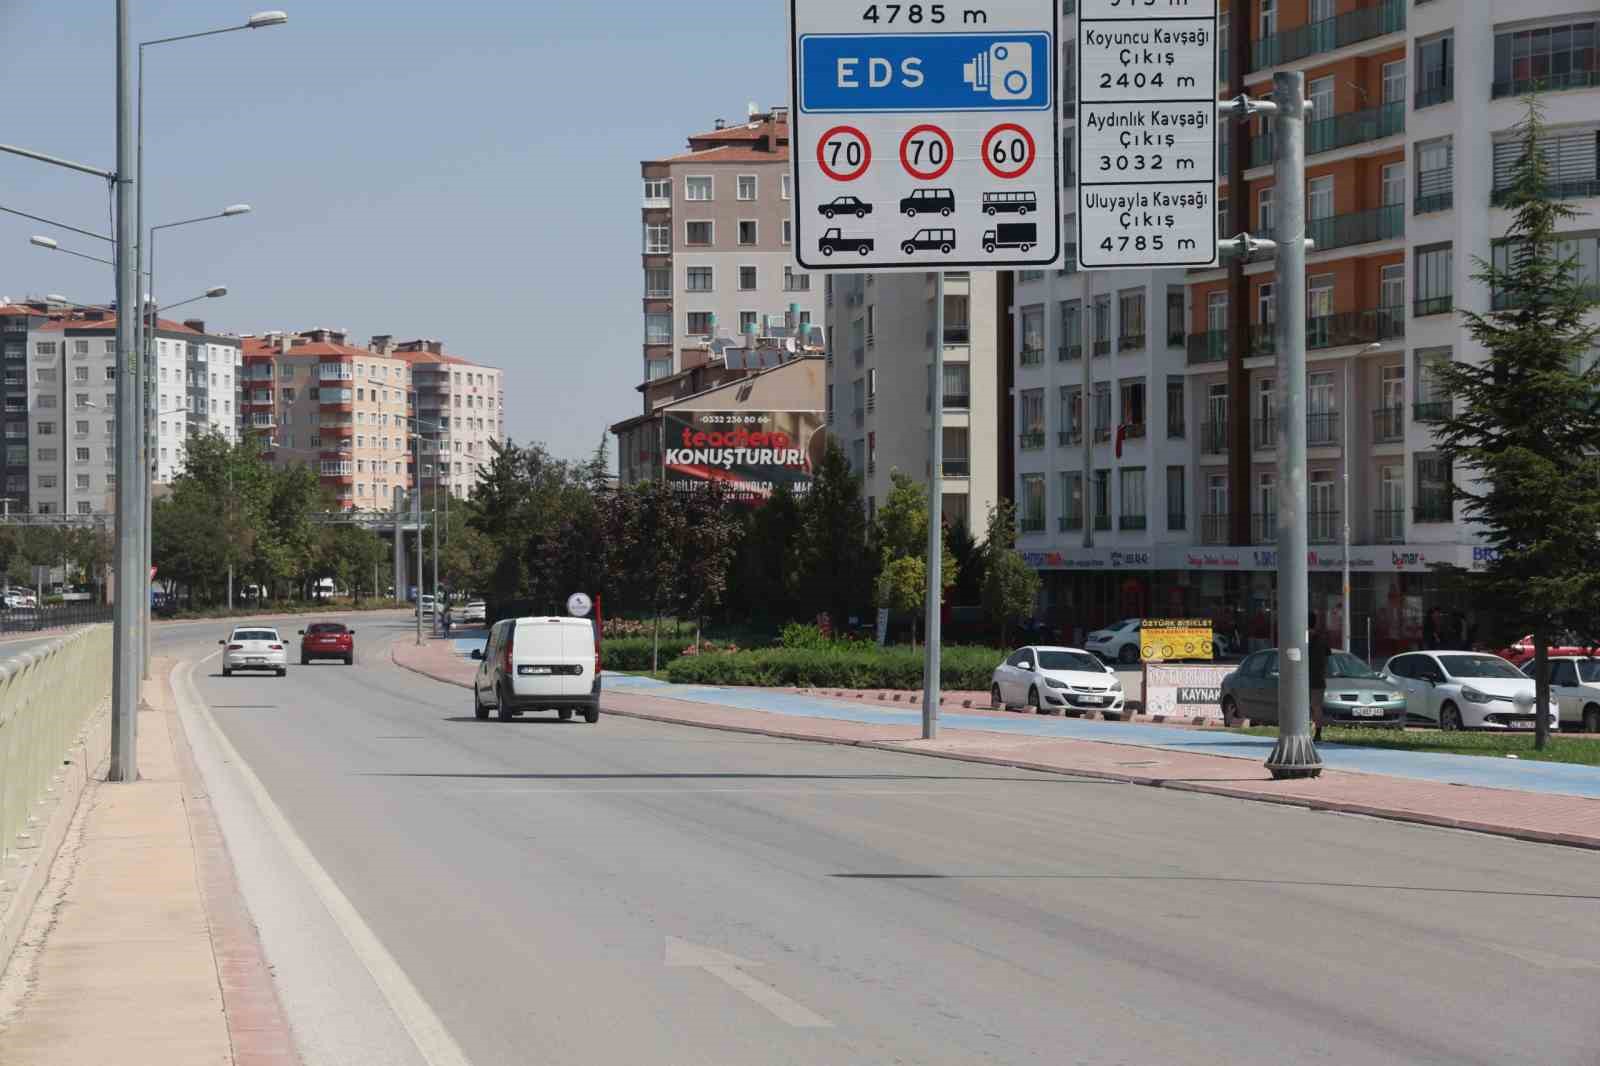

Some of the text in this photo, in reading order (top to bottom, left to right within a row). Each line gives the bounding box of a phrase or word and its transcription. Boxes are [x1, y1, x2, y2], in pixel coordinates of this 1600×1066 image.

[862, 4, 987, 24] 4785 m
[1086, 27, 1209, 49] Koyuncu Kavşağı
[1119, 48, 1175, 67] Çıkış
[837, 57, 924, 88] EDS
[1099, 72, 1195, 89] 2404 m
[1087, 110, 1209, 133] Aydınlık Kavşağı
[1119, 130, 1175, 149] Çıkış
[827, 141, 862, 166] 70
[909, 140, 943, 165] 70
[993, 138, 1026, 164] 60
[1099, 154, 1195, 171] 3032 m
[1085, 191, 1208, 212] Uluyayla Kavşağı
[1119, 211, 1175, 230] Çıkış
[1100, 234, 1196, 252] 4785 m
[702, 415, 725, 424] 0332
[665, 448, 806, 469] KONUŞTURUR!
